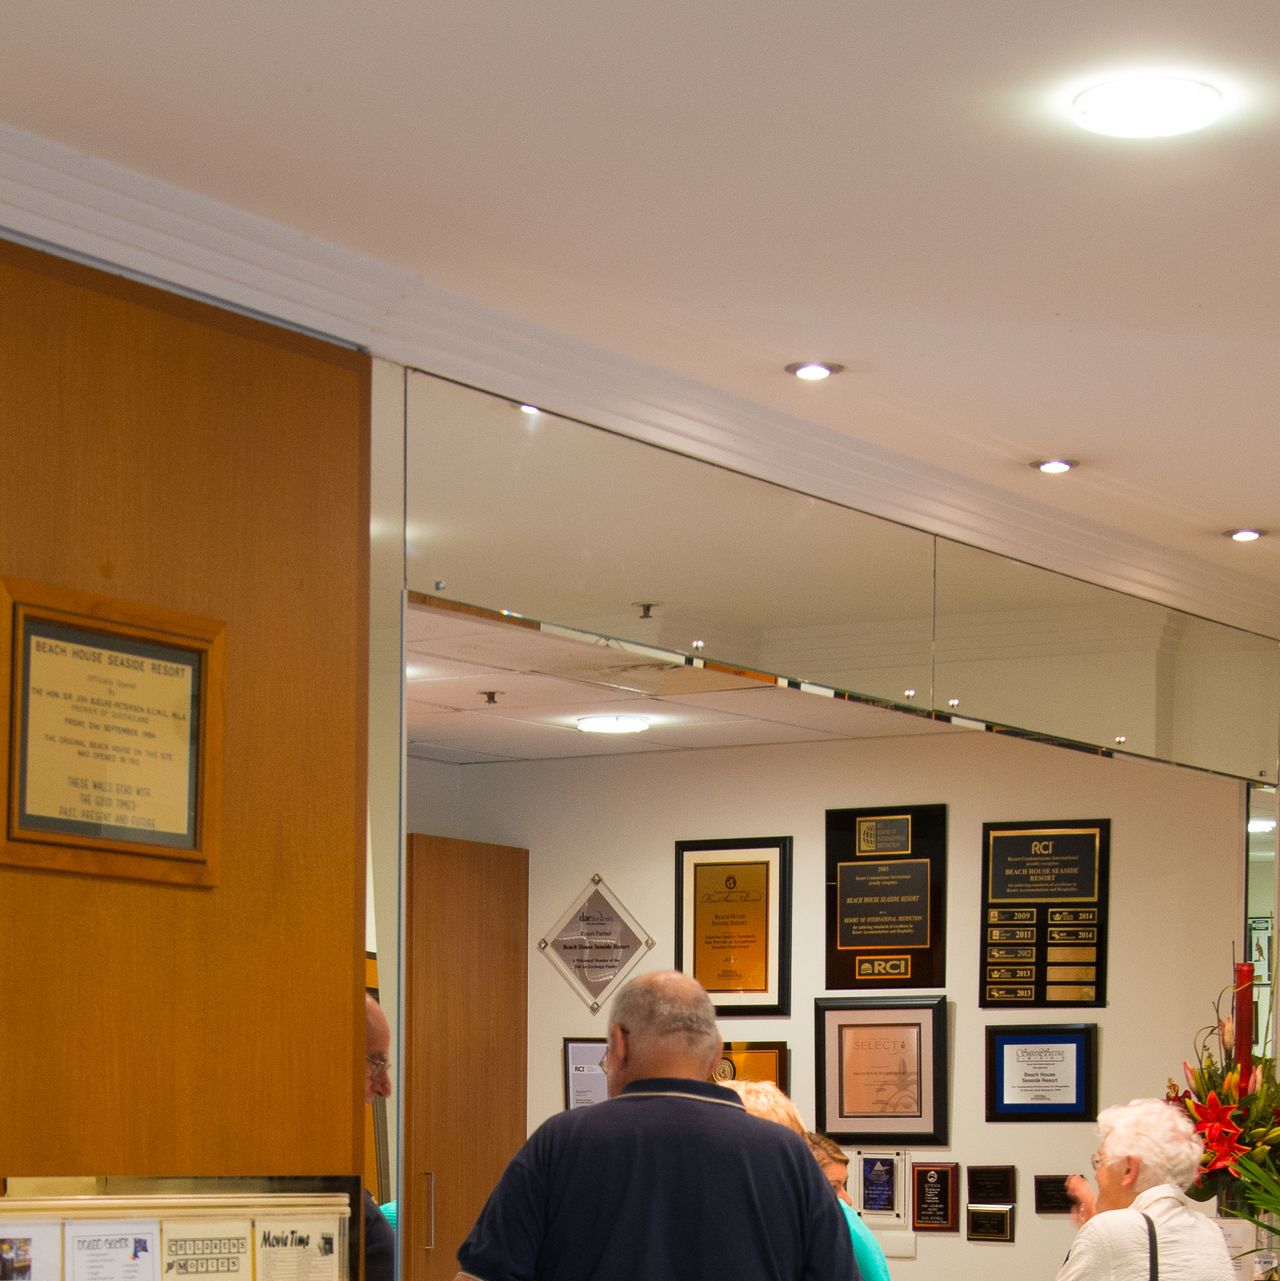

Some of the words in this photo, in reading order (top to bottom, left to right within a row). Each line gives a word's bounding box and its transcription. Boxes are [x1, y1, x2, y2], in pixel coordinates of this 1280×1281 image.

[36, 641, 67, 656] BEACH
[72, 648, 102, 664] HOUSE
[108, 654, 144, 672] SEASIDE
[152, 662, 185, 676] RESORT
[1032, 841, 1053, 854] RCI
[874, 960, 905, 973] RCI
[855, 1041, 898, 1050] SELECT
[261, 1230, 288, 1248] Movie
[290, 1230, 310, 1248] Time
[169, 1238, 246, 1254] CHILDRENS
[178, 1260, 238, 1272] MOVIES
